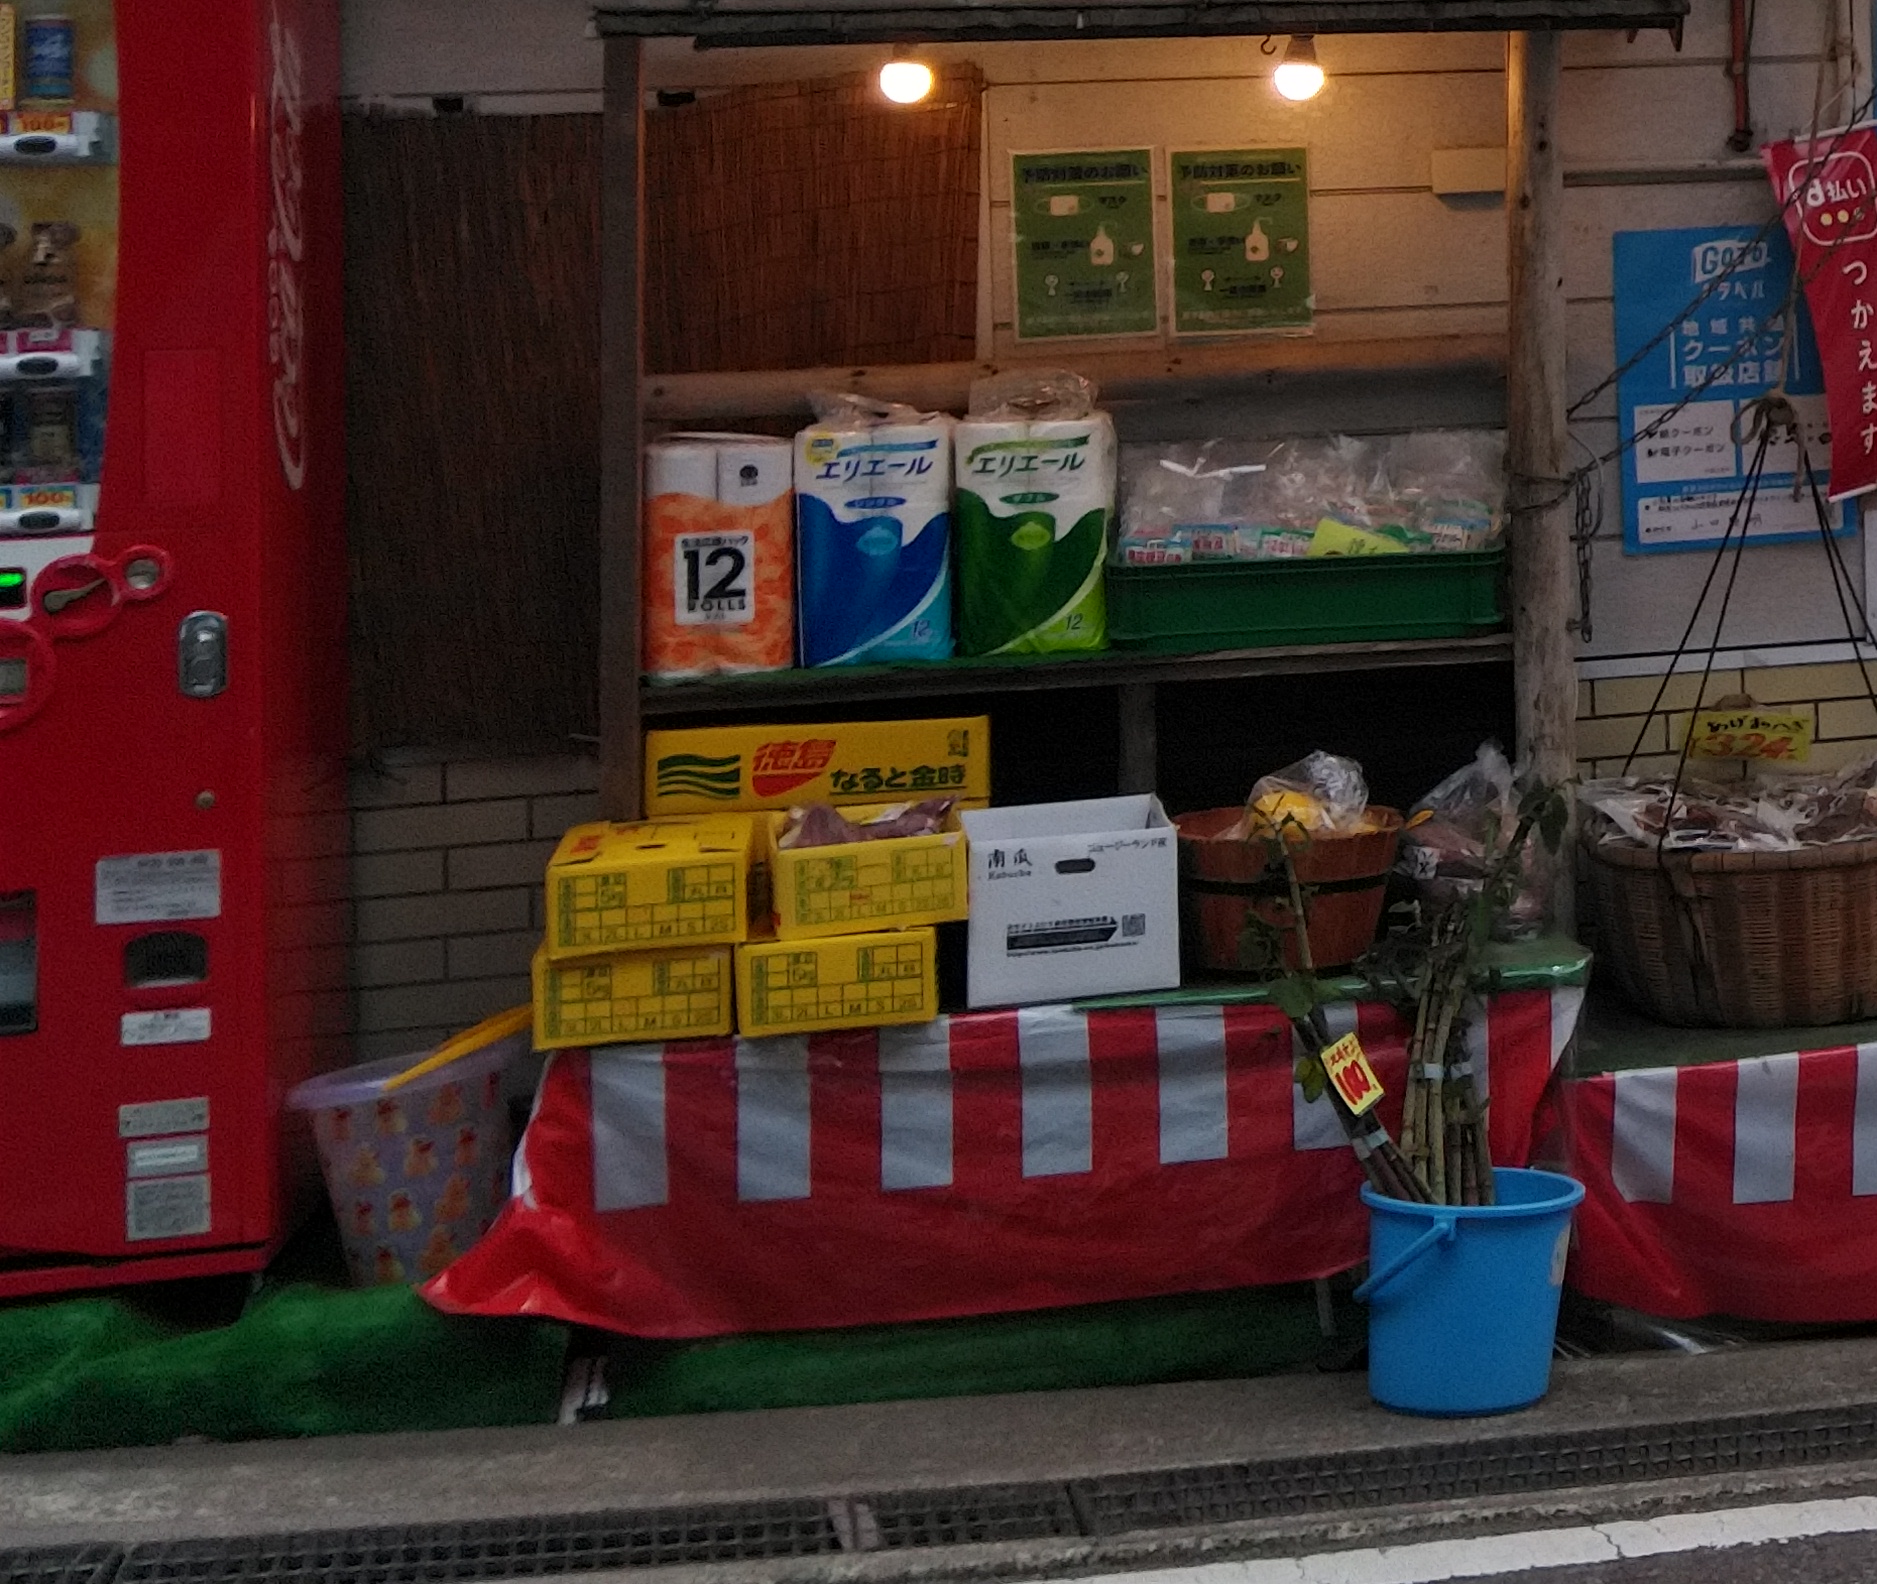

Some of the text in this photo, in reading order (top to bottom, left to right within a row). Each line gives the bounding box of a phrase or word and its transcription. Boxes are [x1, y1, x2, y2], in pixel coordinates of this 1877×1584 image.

[1806, 177, 1868, 207] d払い
[814, 451, 936, 484] エリエール
[971, 448, 1087, 479] エリエール
[683, 546, 749, 602] 12
[750, 739, 836, 772] 徳島
[829, 761, 967, 792] なると金時
